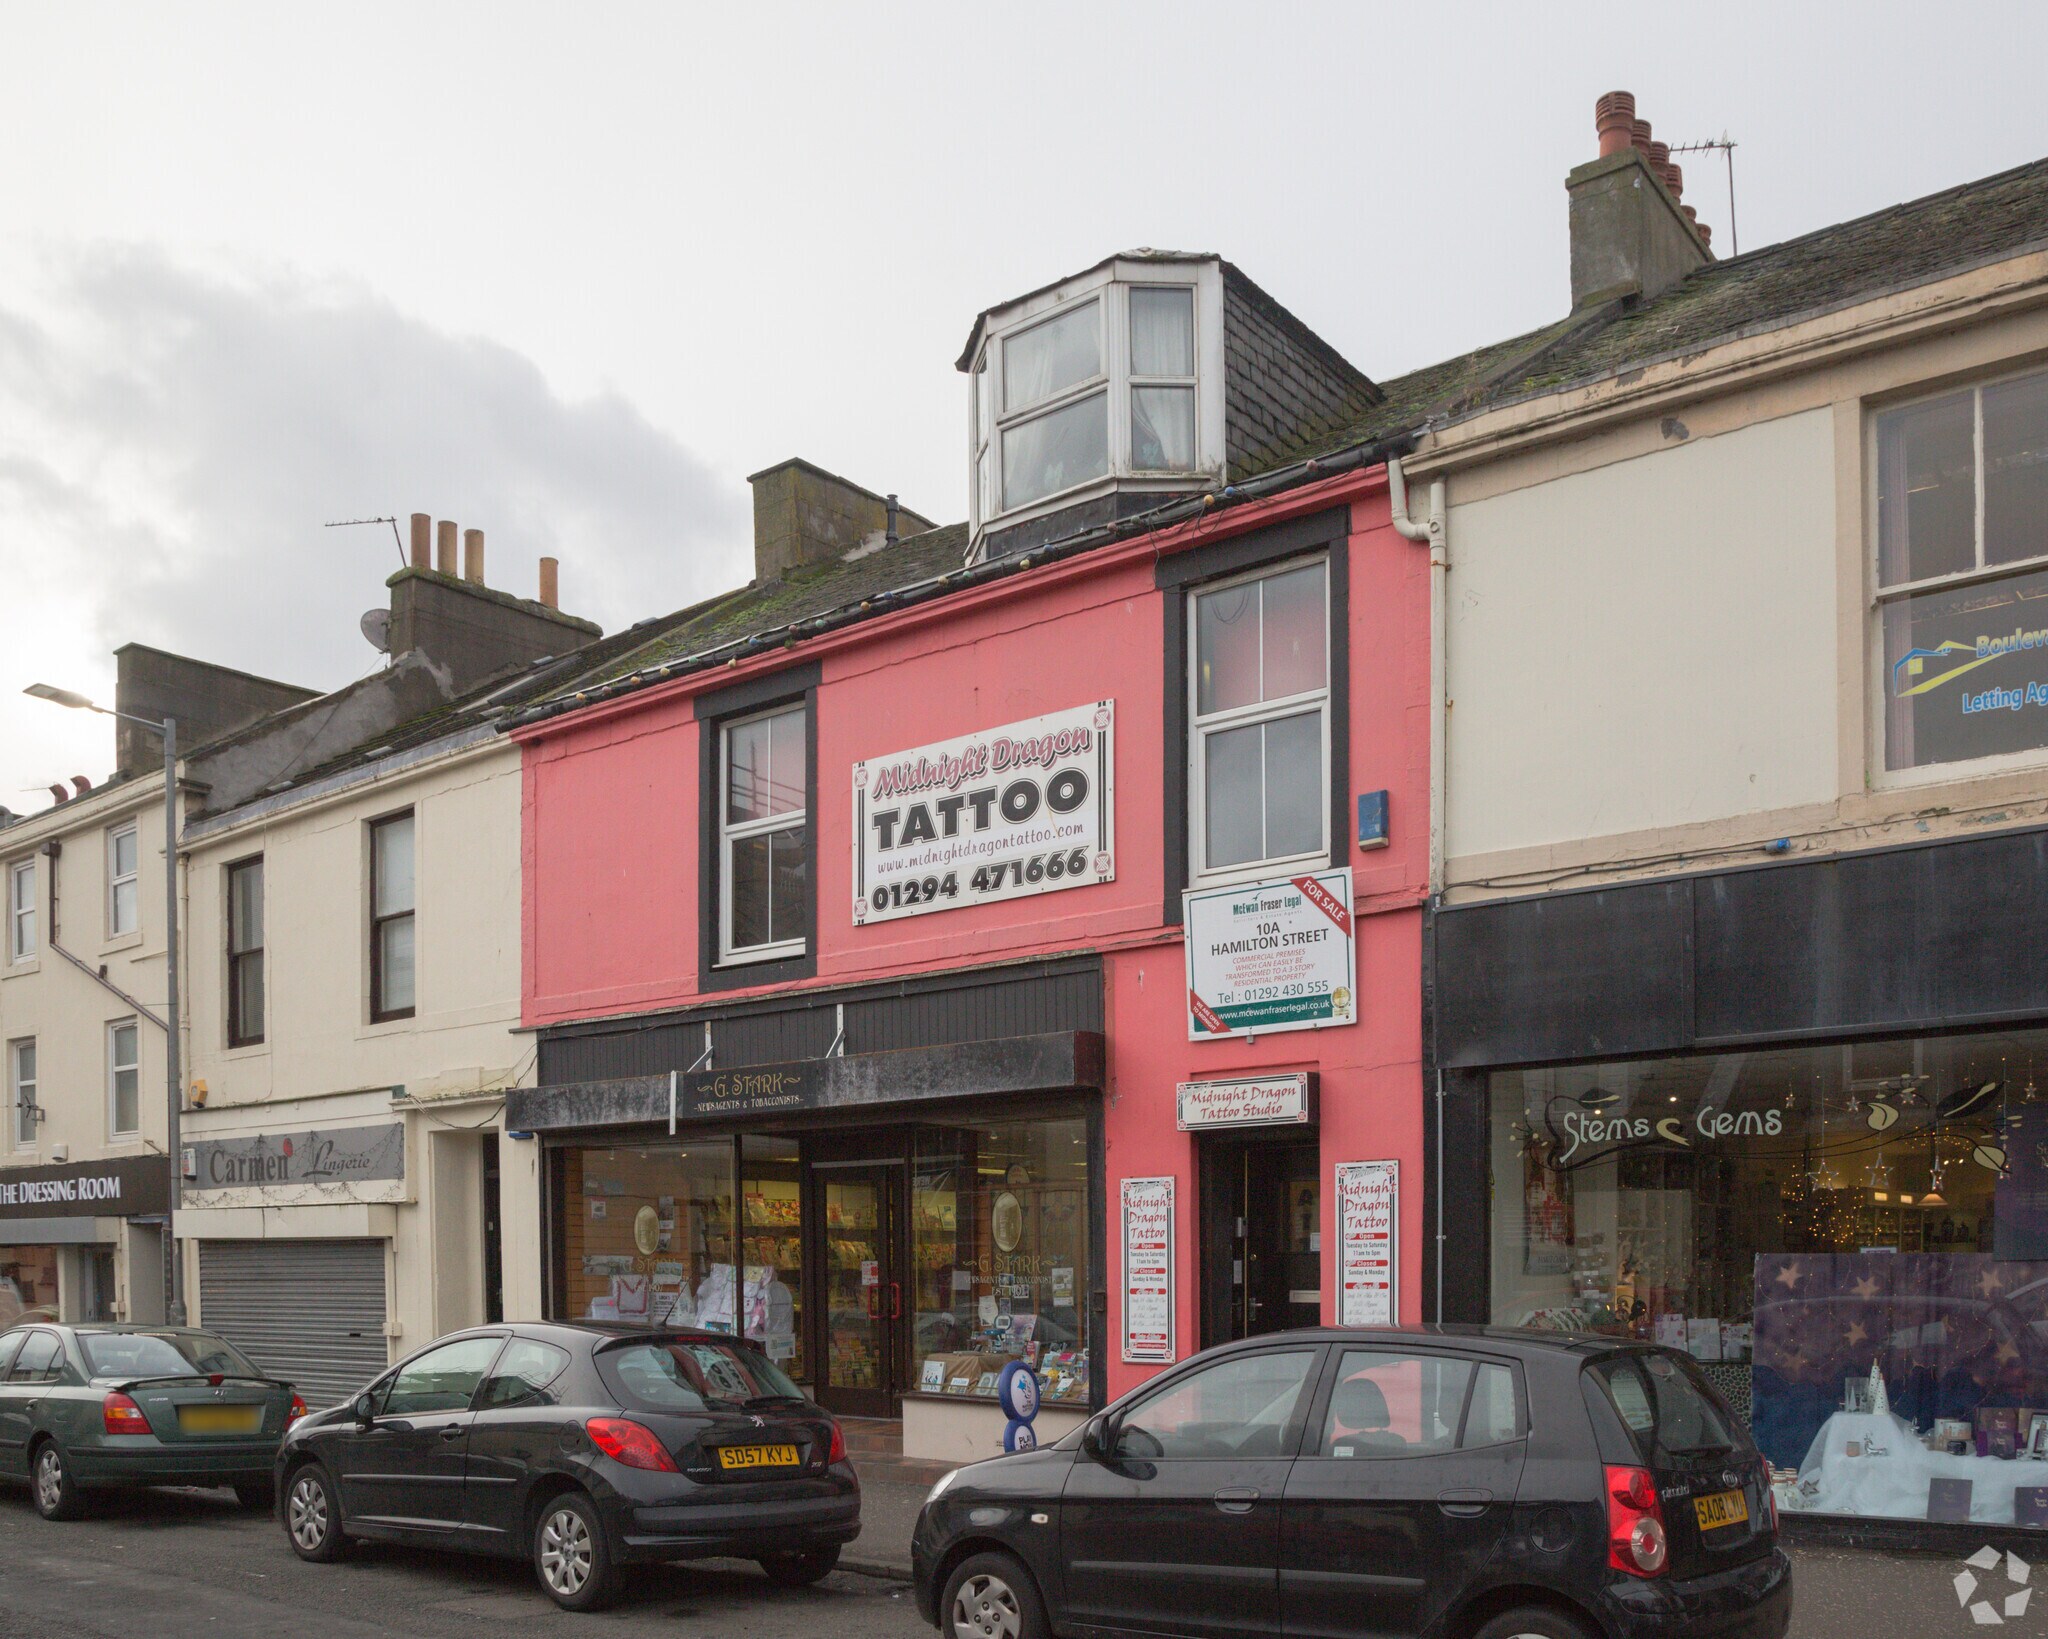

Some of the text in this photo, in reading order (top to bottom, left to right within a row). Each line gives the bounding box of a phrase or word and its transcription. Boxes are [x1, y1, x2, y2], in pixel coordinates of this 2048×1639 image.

[1962, 687, 2022, 714] Letting
[872, 726, 1092, 800] Midnight Dragon
[872, 766, 1090, 852] TATTOO
[877, 822, 1084, 874] www.midnightdragontattoo.com
[871, 846, 1090, 912] 01294 471666
[1233, 894, 1302, 916] McEwan Fraser Legal
[1302, 879, 1346, 923] FOR SALE
[1256, 922, 1280, 935] 10A
[1211, 928, 1329, 956] HAMILTON STREET
[1232, 948, 1306, 965] COMMERCIAL PREMISES
[1235, 956, 1304, 972] WHICH CAN EASILY BE
[1225, 968, 1271, 980] TRANSFORMED
[1272, 966, 1281, 974] TO
[1234, 972, 1307, 987] RESIDENTIAL PROPERTY
[1217, 991, 1234, 1004] Tel
[1244, 987, 1279, 1001] 01292
[1282, 983, 1304, 996] 430
[1307, 980, 1329, 994] 555
[1218, 1000, 1330, 1020] www.mcewanfraserlegal.co.uk
[714, 1072, 784, 1098] G. STARK
[742, 1100, 748, 1109] &
[1190, 1086, 1297, 1107] Midnight Dragon
[1200, 1101, 1283, 1120] Tattoo Studio
[1559, 1105, 1782, 1163] Stems Gems
[210, 1149, 289, 1184] Carmen
[301, 1139, 370, 1178] Lingerie
[19, 1179, 76, 1204] DRESSING
[78, 1176, 121, 1200] ROOM
[1337, 1179, 1397, 1201] Midnight
[1122, 1194, 1173, 1213] Midnight
[1343, 1198, 1391, 1216] Dragon
[1127, 1211, 1168, 1228] Dragon
[1347, 1215, 1388, 1229] Tattoo
[1130, 1227, 1165, 1240] Tattoo
[1369, 1241, 1388, 1249] Saturday
[994, 1253, 1042, 1274] STARK
[1368, 1268, 1385, 1276] Monday
[725, 1445, 793, 1466] SD57 KYJ
[1698, 1497, 1727, 1524] SA08
